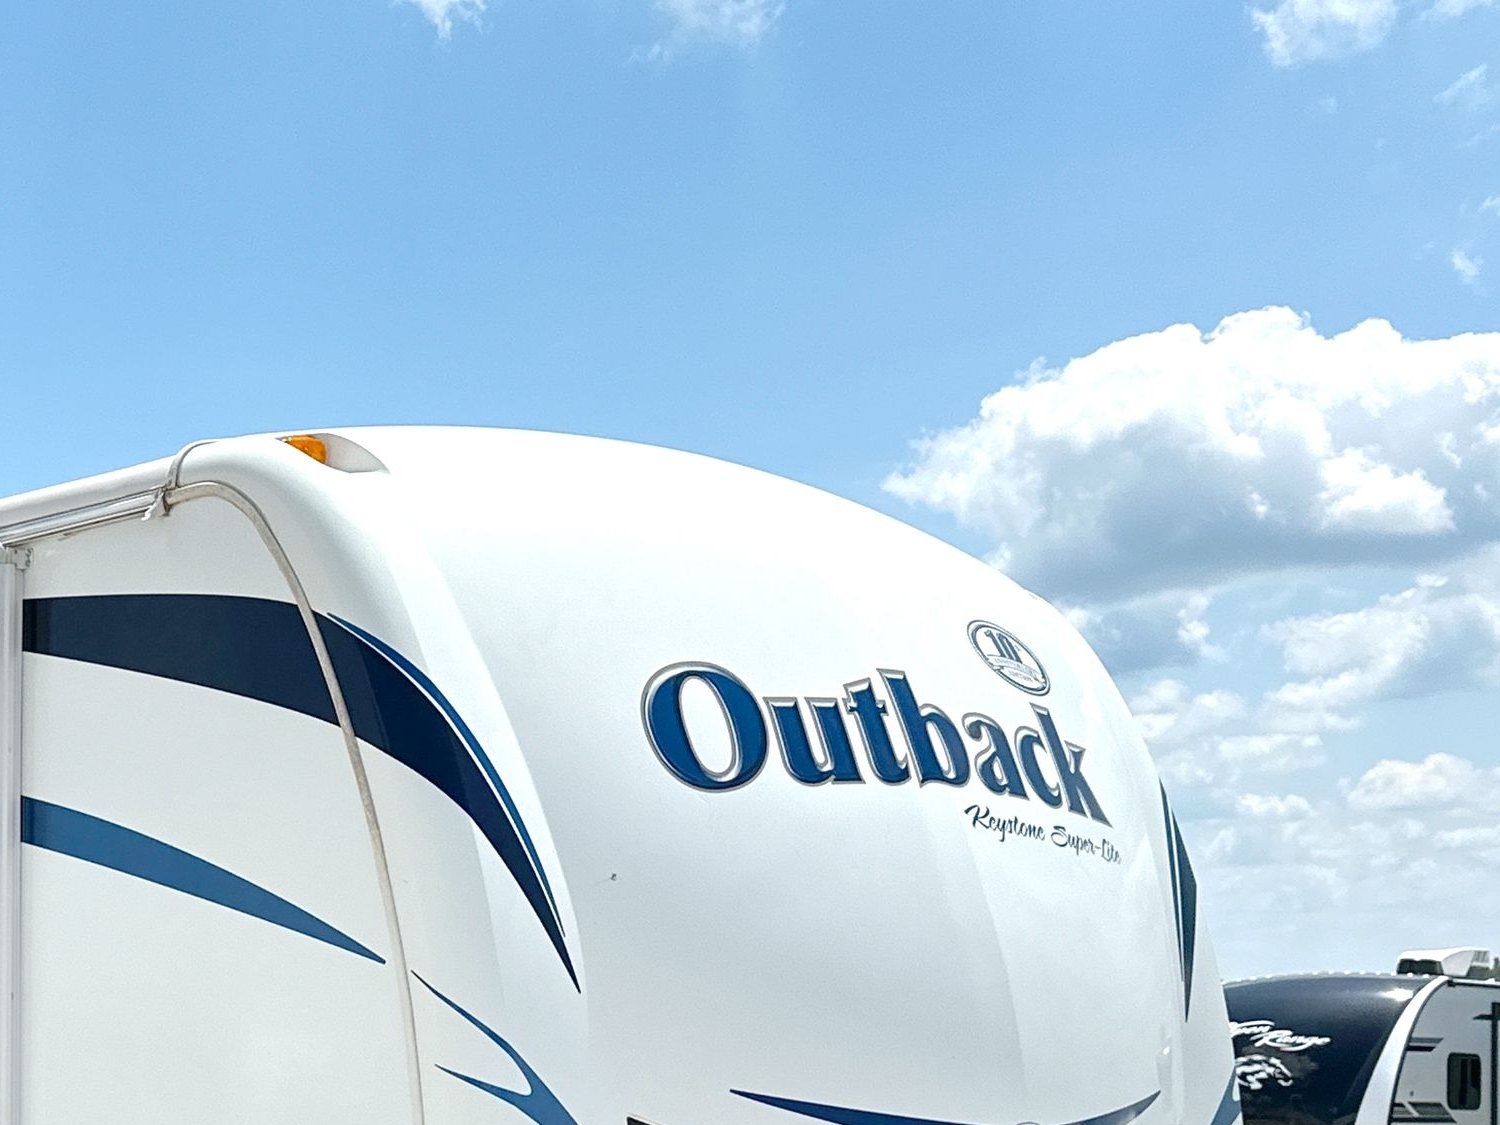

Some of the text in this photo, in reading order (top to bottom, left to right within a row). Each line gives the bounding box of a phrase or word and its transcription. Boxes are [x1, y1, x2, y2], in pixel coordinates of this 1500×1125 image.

[640, 661, 1114, 828] Outback
[963, 804, 1122, 865] Keystone Super-Lite
[1249, 1030, 1331, 1052] Range
